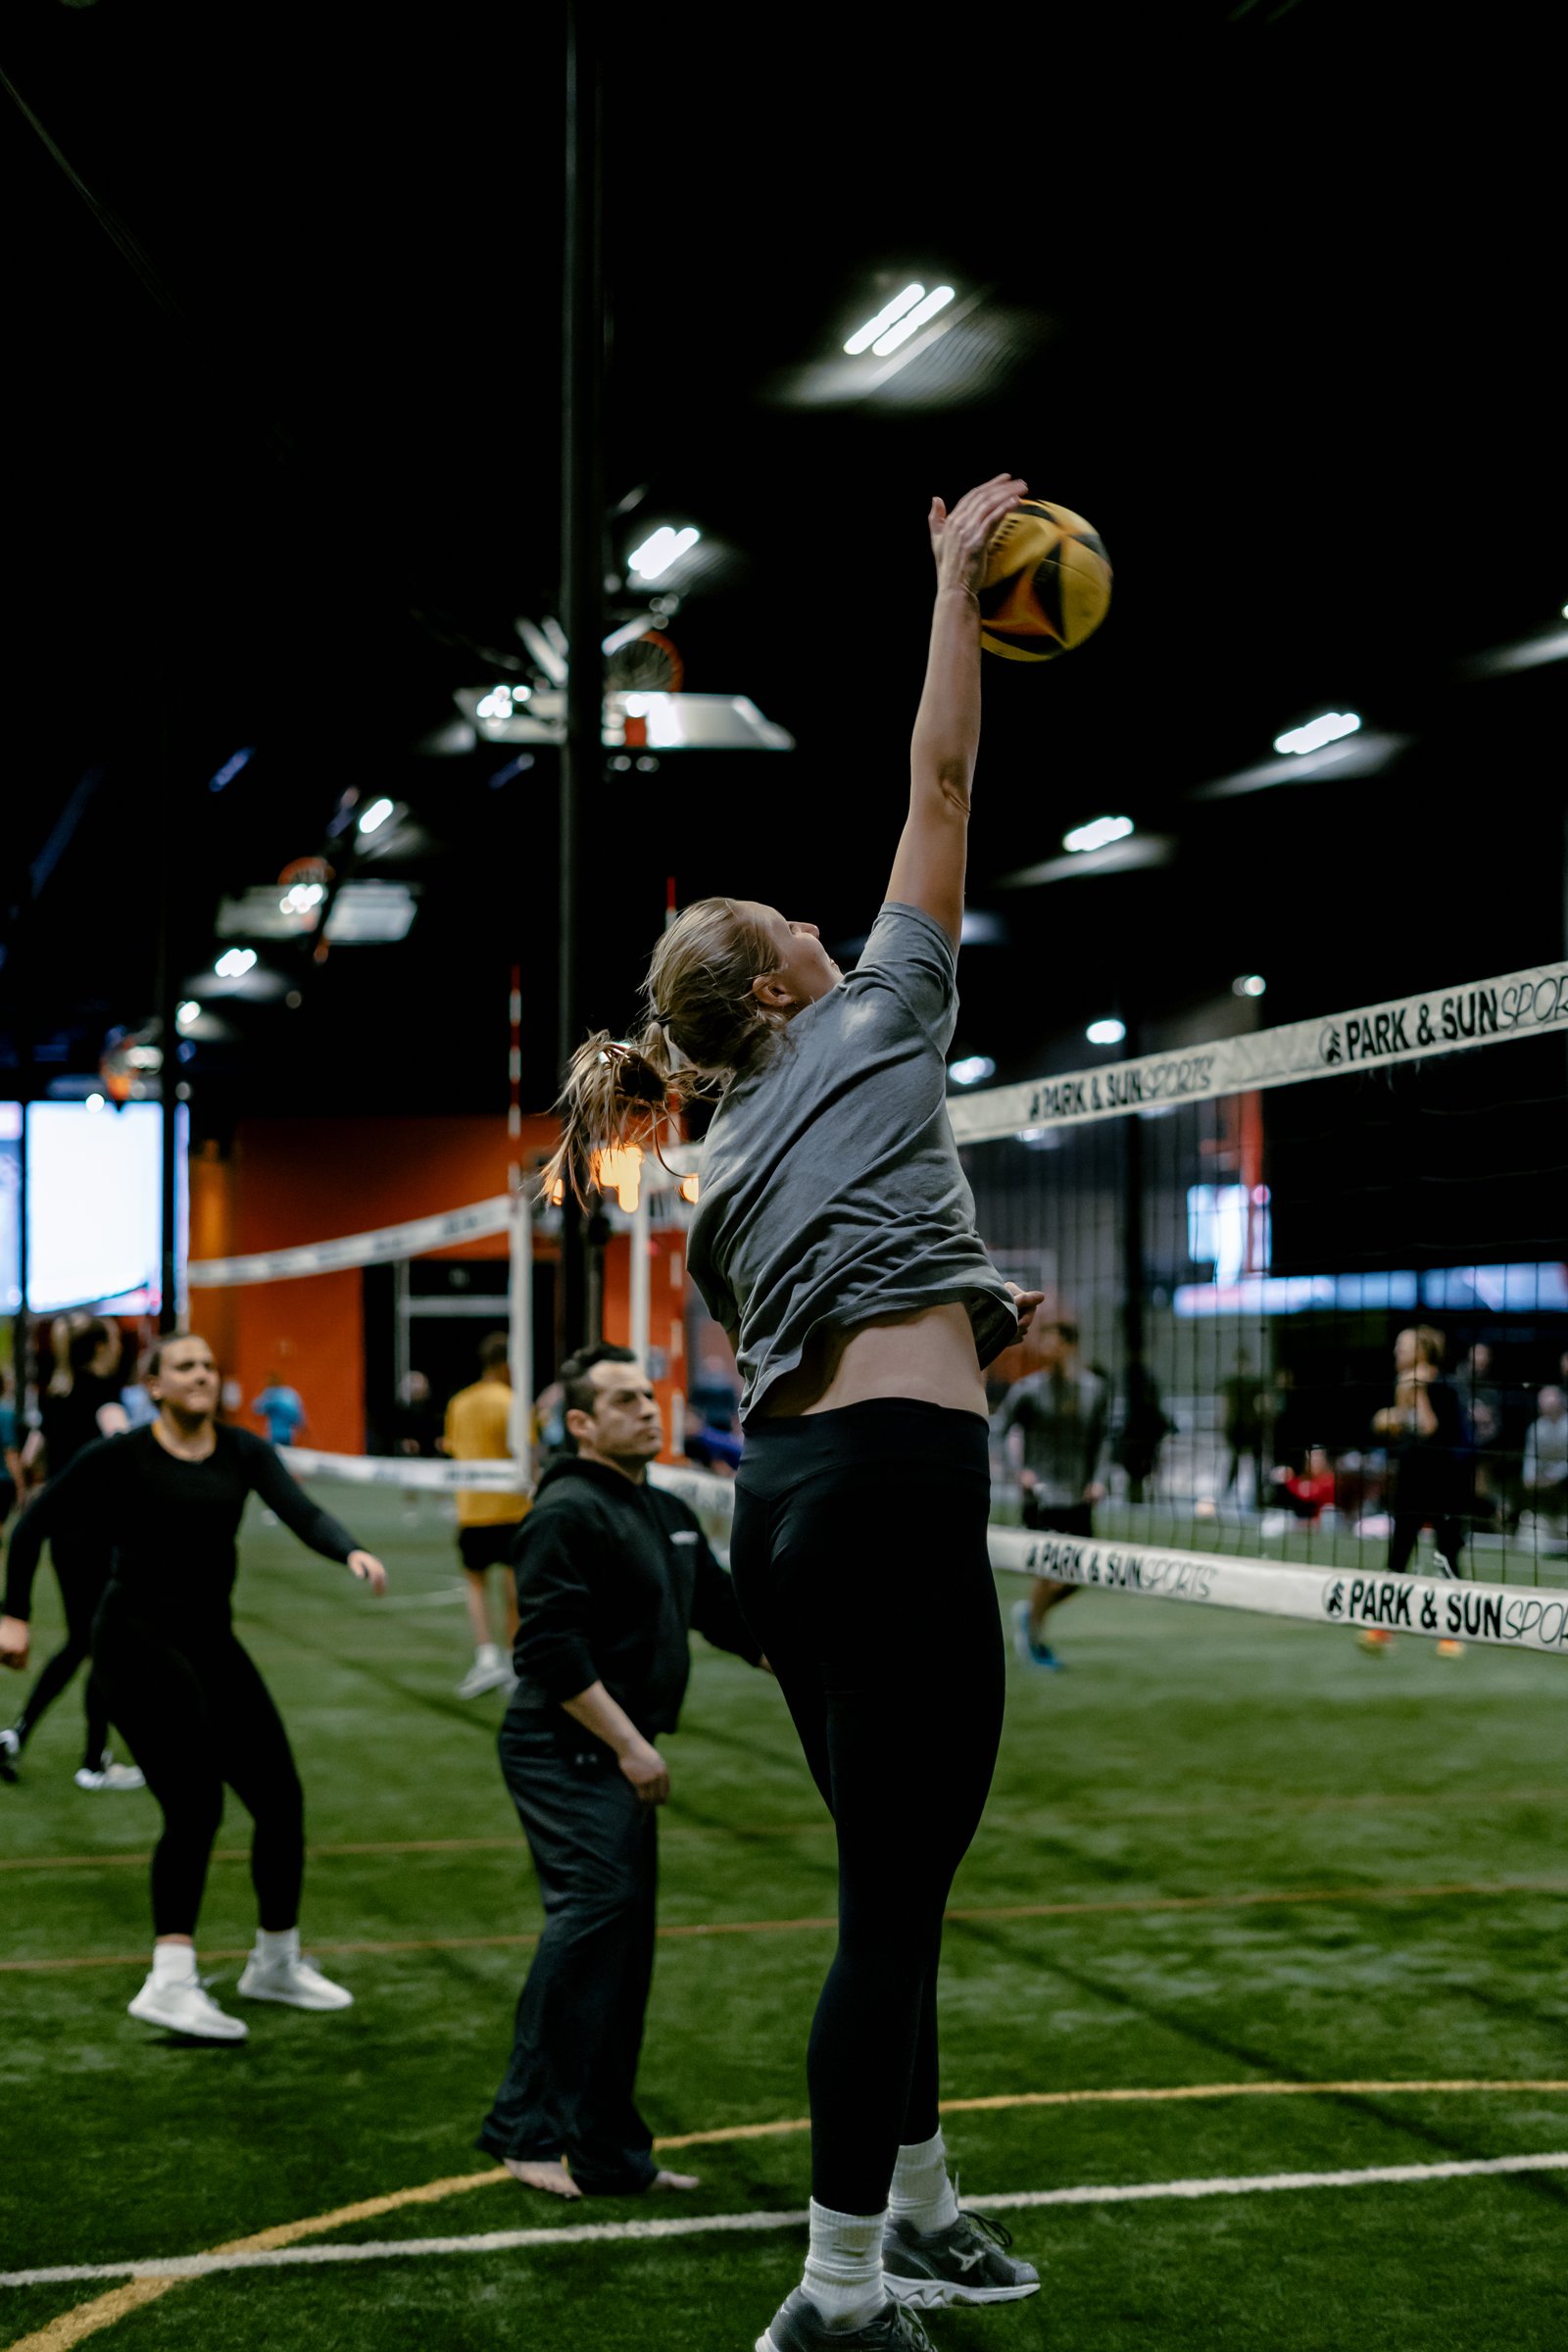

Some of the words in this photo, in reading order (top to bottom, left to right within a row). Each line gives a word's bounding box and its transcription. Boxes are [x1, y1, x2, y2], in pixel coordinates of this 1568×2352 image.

[1345, 1007, 1411, 1061] PARK
[1417, 1004, 1436, 1047] &
[1441, 988, 1499, 1041] SUN
[1044, 1079, 1086, 1118] PARK
[1091, 1076, 1102, 1110] &
[1042, 1541, 1084, 1580] PARK
[1349, 1579, 1415, 1627] PARK
[1421, 1589, 1438, 1630] &
[1446, 1590, 1503, 1640] SUN
